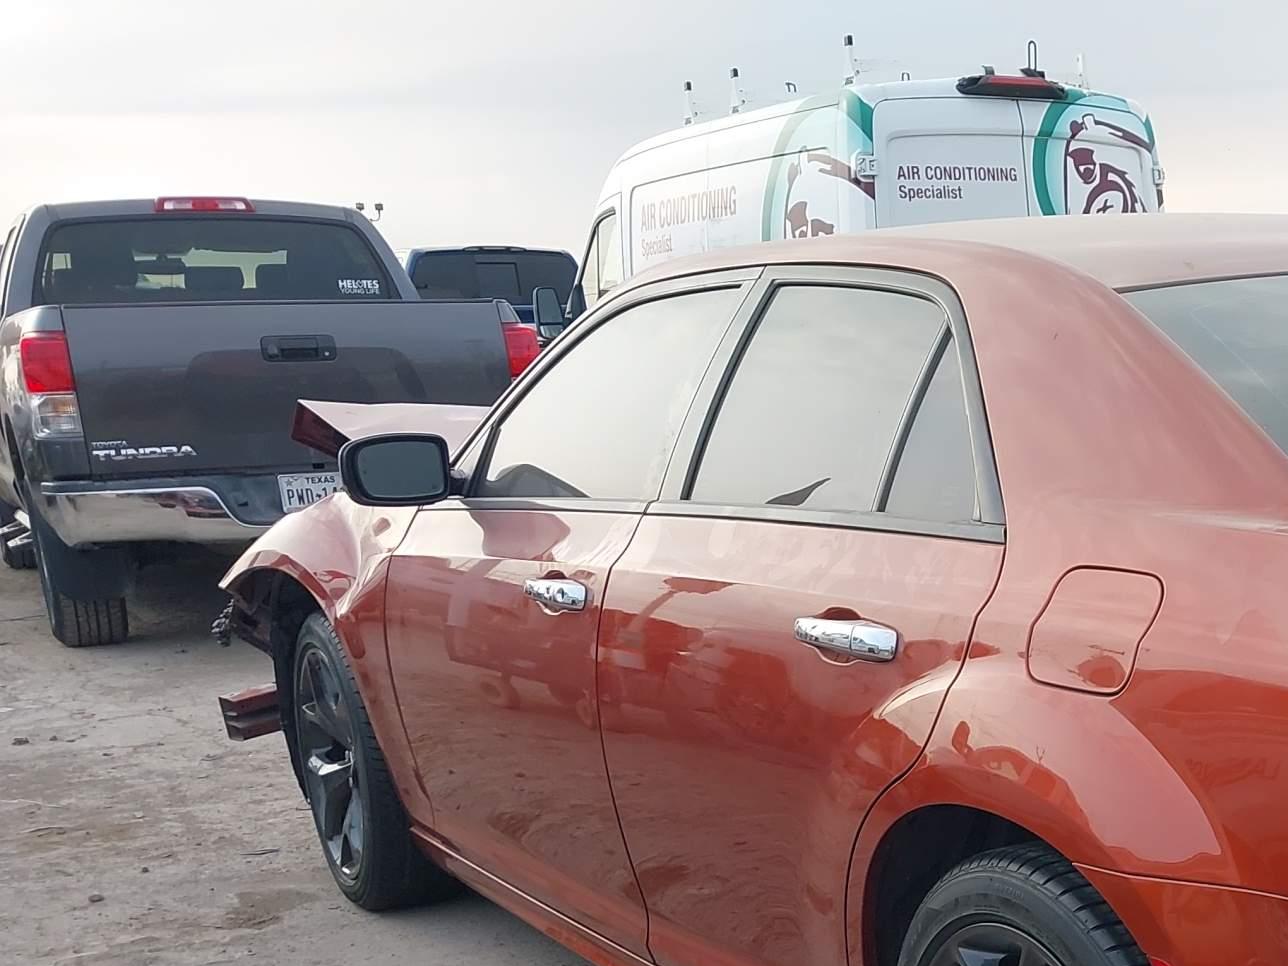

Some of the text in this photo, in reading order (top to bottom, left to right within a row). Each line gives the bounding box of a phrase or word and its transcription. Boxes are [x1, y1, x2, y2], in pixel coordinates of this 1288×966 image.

[897, 165, 1018, 182] AIR CONDITIONING
[898, 184, 963, 202] Specialist
[640, 185, 737, 233] AIR CONDITIONING
[641, 232, 672, 260] Specialist
[91, 440, 129, 449] TOYOTA
[91, 445, 198, 461] TUNDRA
[304, 475, 336, 485] TEXAS
